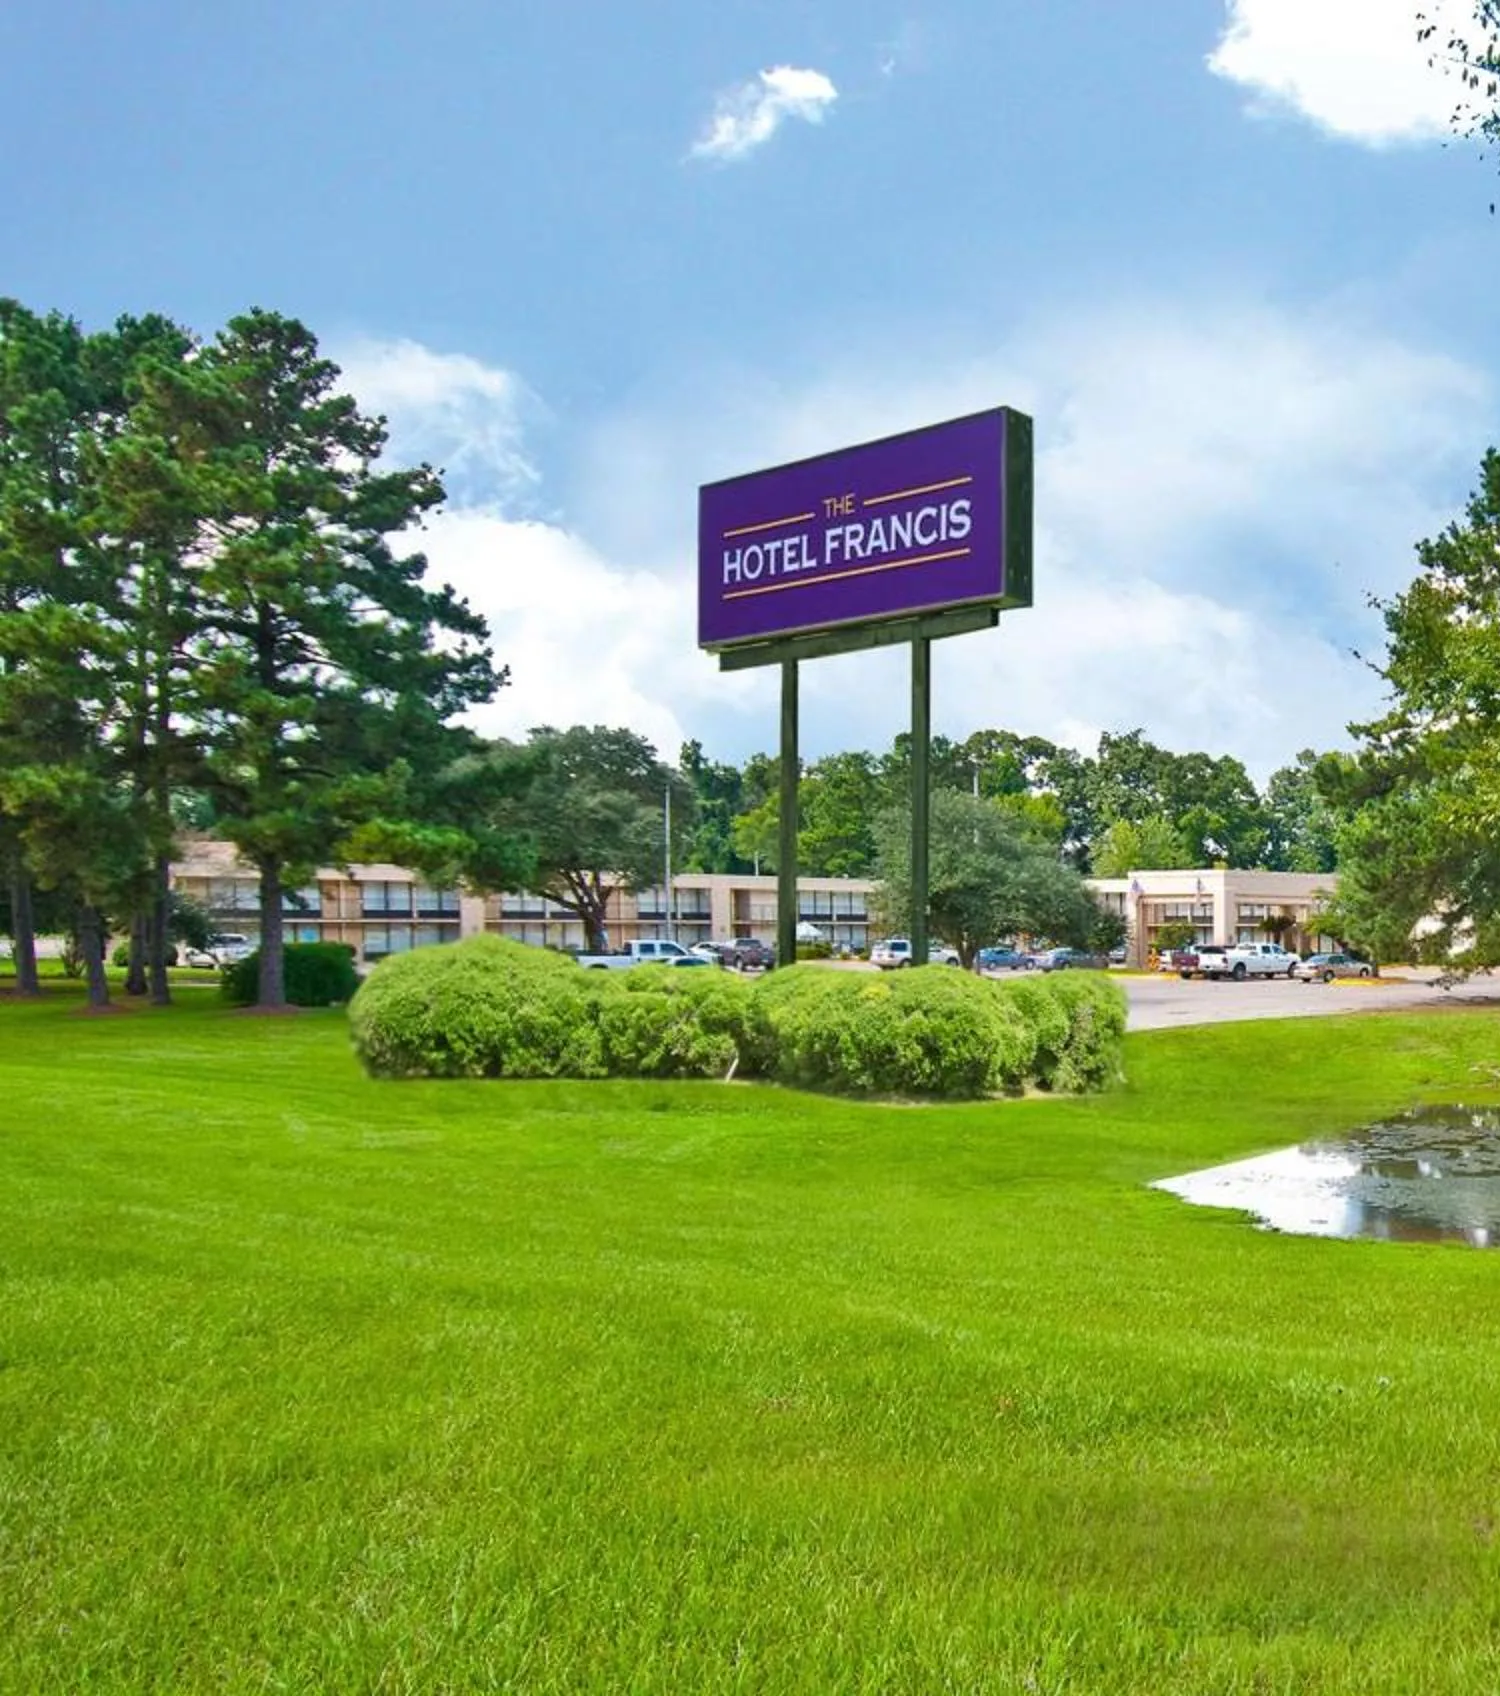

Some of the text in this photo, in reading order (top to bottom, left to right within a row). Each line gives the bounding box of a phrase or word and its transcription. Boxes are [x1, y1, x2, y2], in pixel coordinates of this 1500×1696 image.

[823, 493, 856, 518] THE
[722, 499, 972, 584] HOTEL FRANCIS
